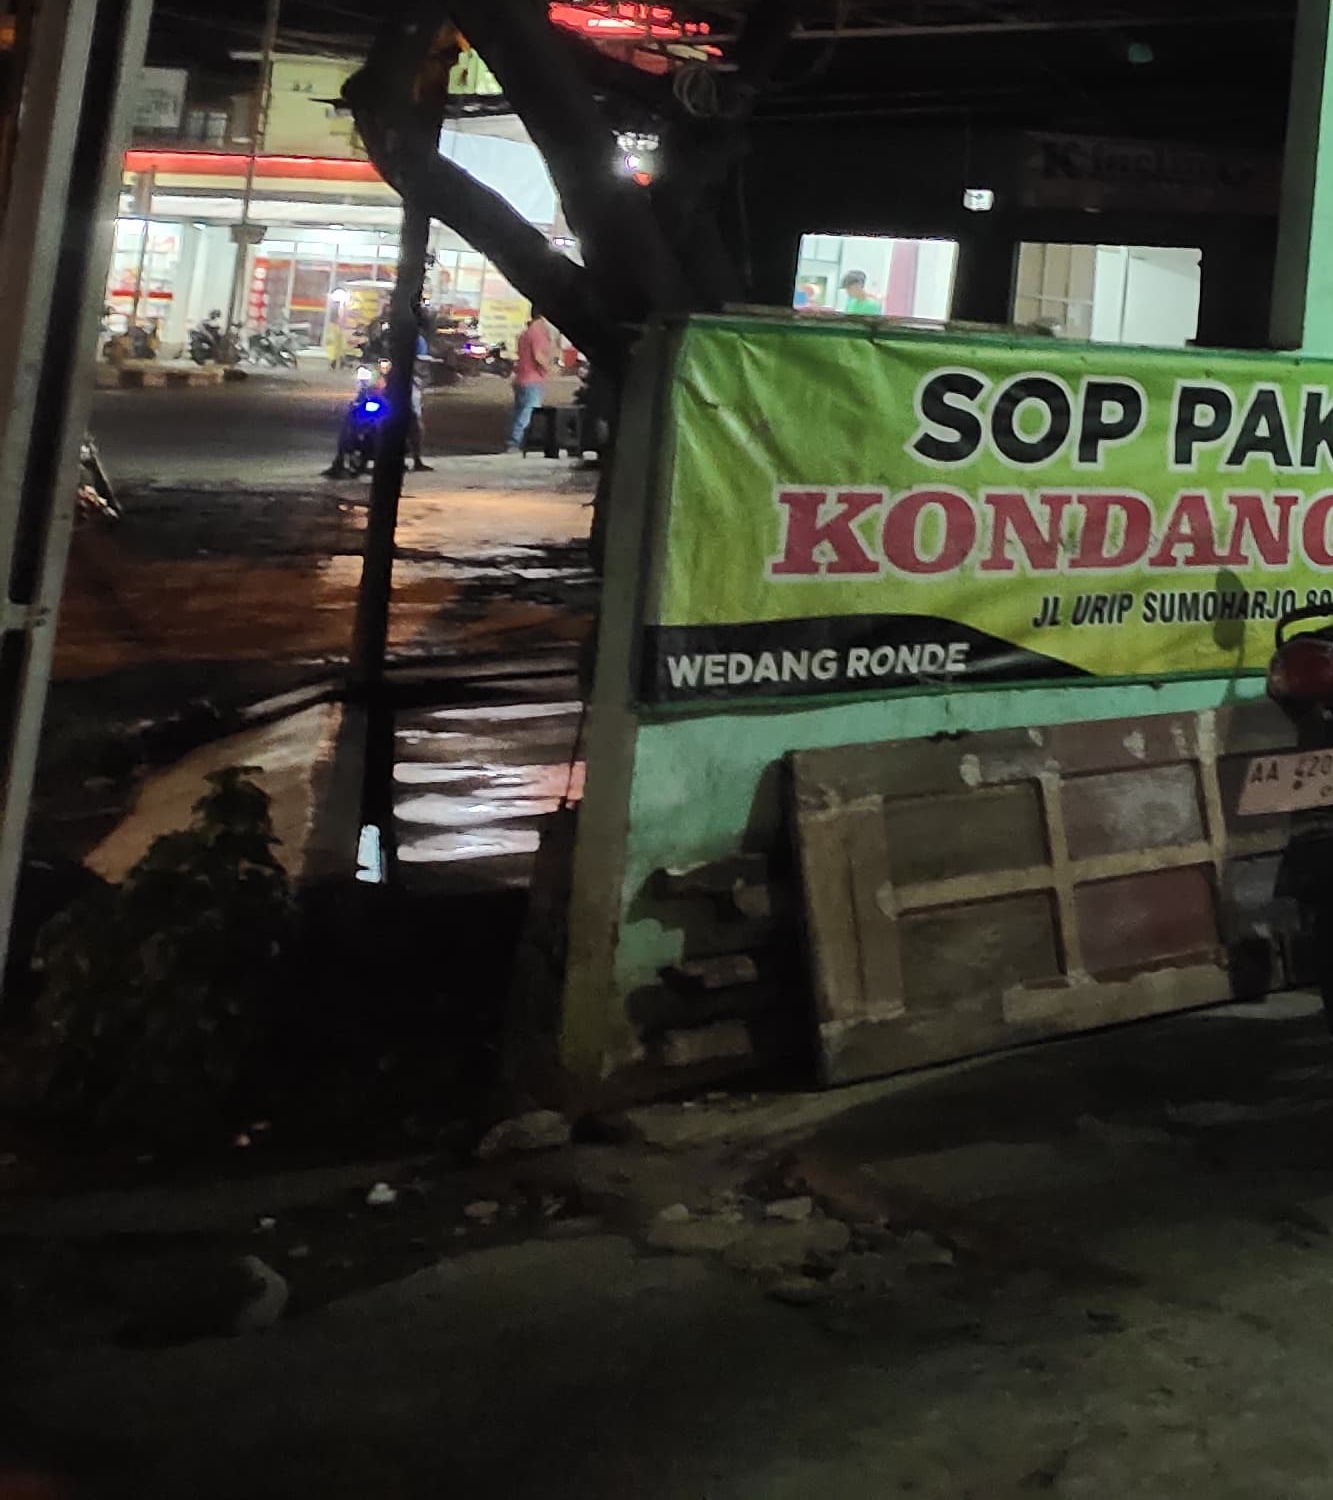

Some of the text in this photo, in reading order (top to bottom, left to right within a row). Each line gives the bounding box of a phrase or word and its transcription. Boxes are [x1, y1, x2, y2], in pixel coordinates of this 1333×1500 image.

[911, 371, 1143, 464] SOP
[1032, 596, 1061, 628] JL
[1071, 592, 1134, 625] URIP
[1142, 588, 1297, 622] SUMOHARJO
[667, 642, 970, 688] WEDANG RONDE
[1250, 759, 1280, 784] AA
